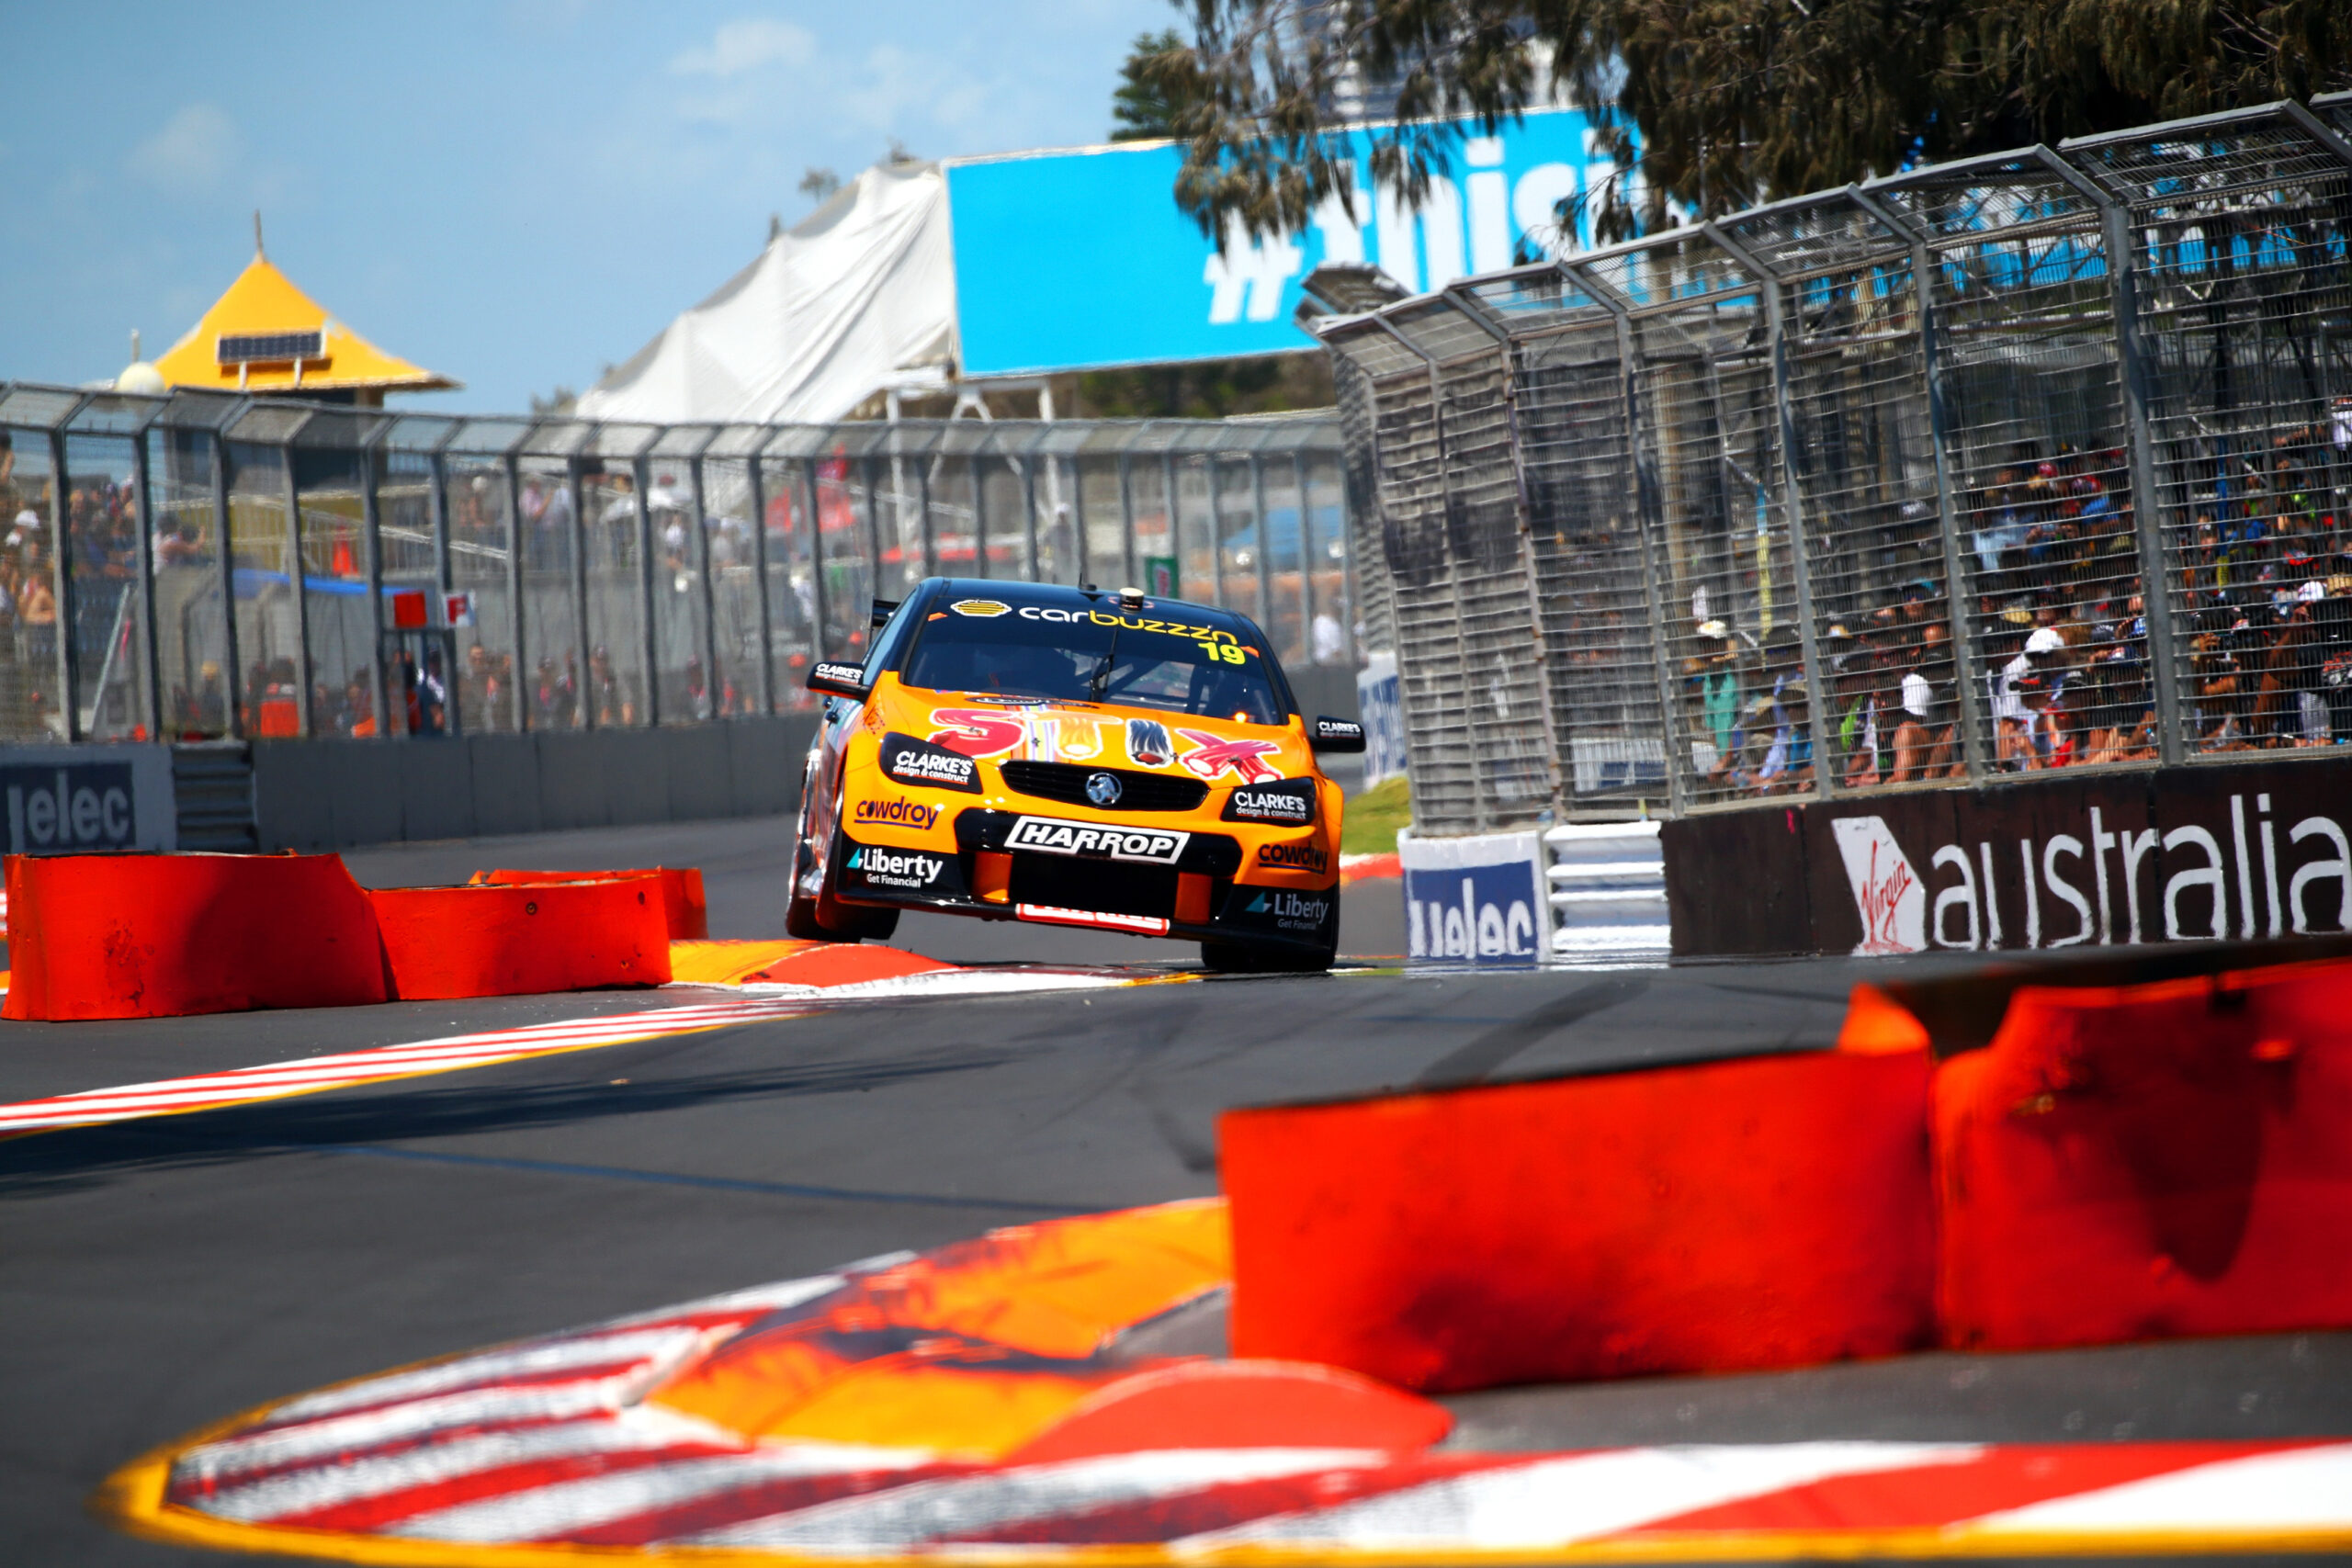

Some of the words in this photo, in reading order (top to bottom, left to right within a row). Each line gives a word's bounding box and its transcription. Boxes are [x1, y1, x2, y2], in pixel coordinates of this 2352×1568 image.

[1198, 641, 1246, 665] 19
[816, 663, 863, 679] CLARKE'S
[1318, 721, 1360, 733] CLARKE'S
[896, 750, 973, 775] CLARKE'S
[892, 765, 920, 777] design
[921, 767, 928, 776] &
[929, 770, 969, 784] construct
[1234, 791, 1306, 811] CLARKE'S
[856, 795, 942, 830] cowdroy
[1236, 807, 1262, 818] design
[1263, 808, 1270, 817] &
[1271, 809, 1306, 820] construct
[1021, 823, 1174, 855] HARROP
[864, 848, 944, 884] Liberty
[1932, 793, 2352, 952] australia
[866, 874, 880, 884] Get
[881, 874, 922, 888] Financial
[1273, 893, 1329, 924] Liberty
[1277, 919, 1293, 929] Get
